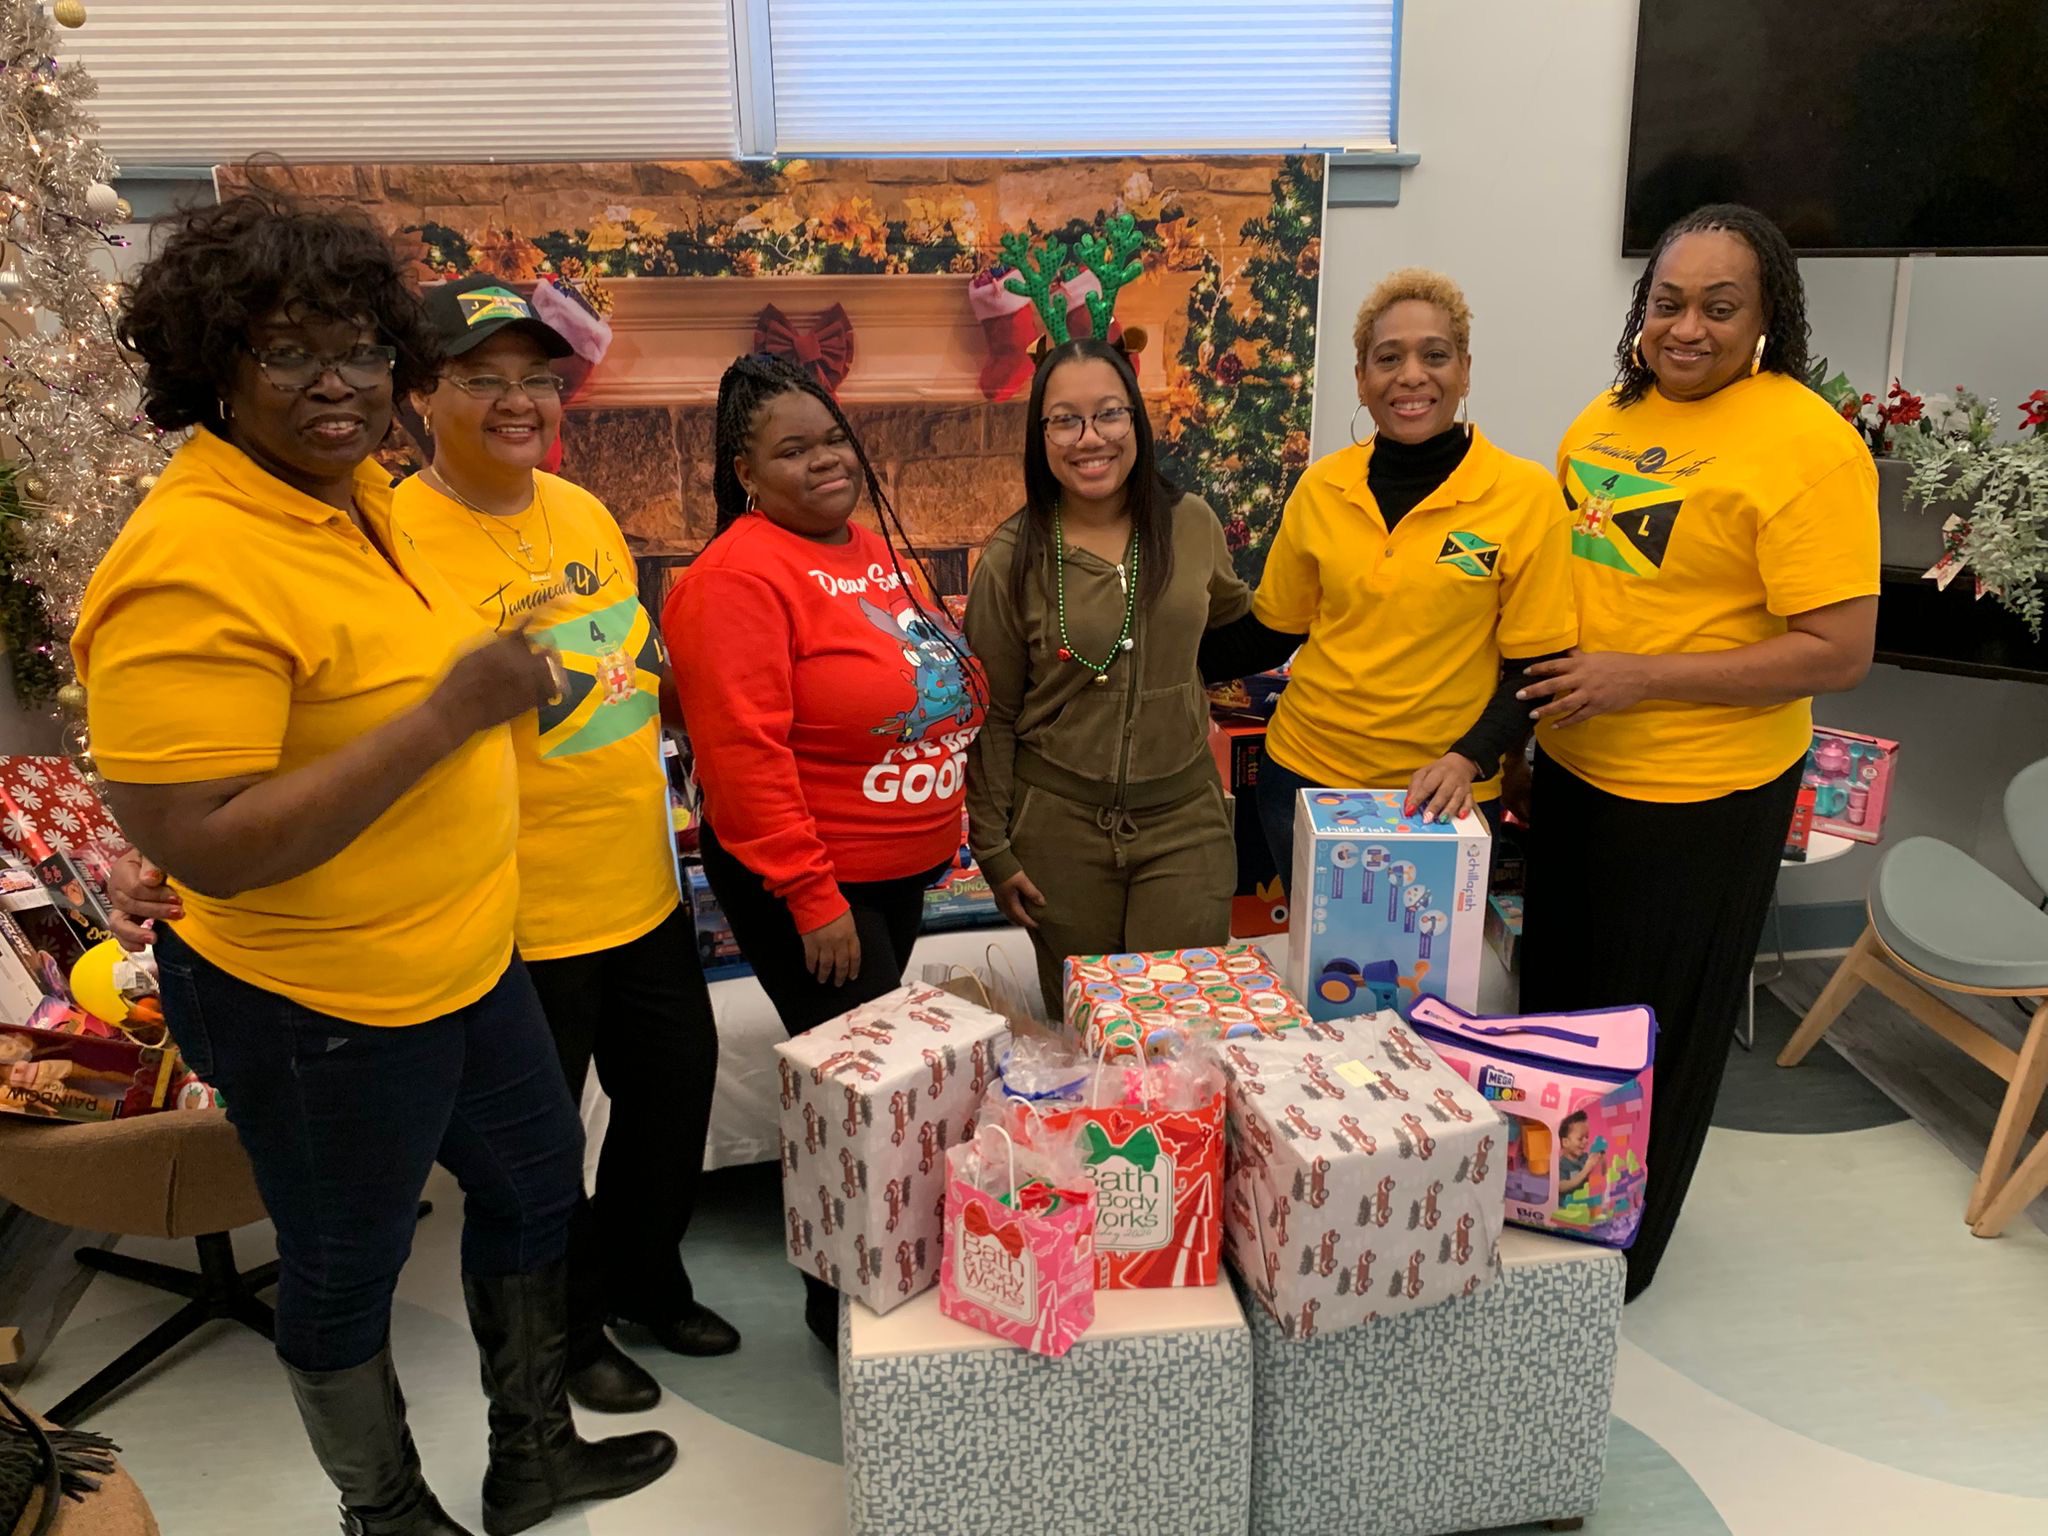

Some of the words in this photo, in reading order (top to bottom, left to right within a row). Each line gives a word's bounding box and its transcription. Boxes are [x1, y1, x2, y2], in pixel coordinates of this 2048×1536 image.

[1601, 474, 1620, 491] 4
[1638, 514, 1650, 537] L
[1447, 543, 1456, 553] J
[807, 569, 869, 597] Dear
[589, 620, 606, 643] 4
[7, 1087, 98, 1112] RAINBOW
[1096, 1191, 1158, 1214] Body
[1095, 1208, 1159, 1229] orks
[963, 1230, 1025, 1278] Bath
[963, 1261, 1025, 1306] Works
